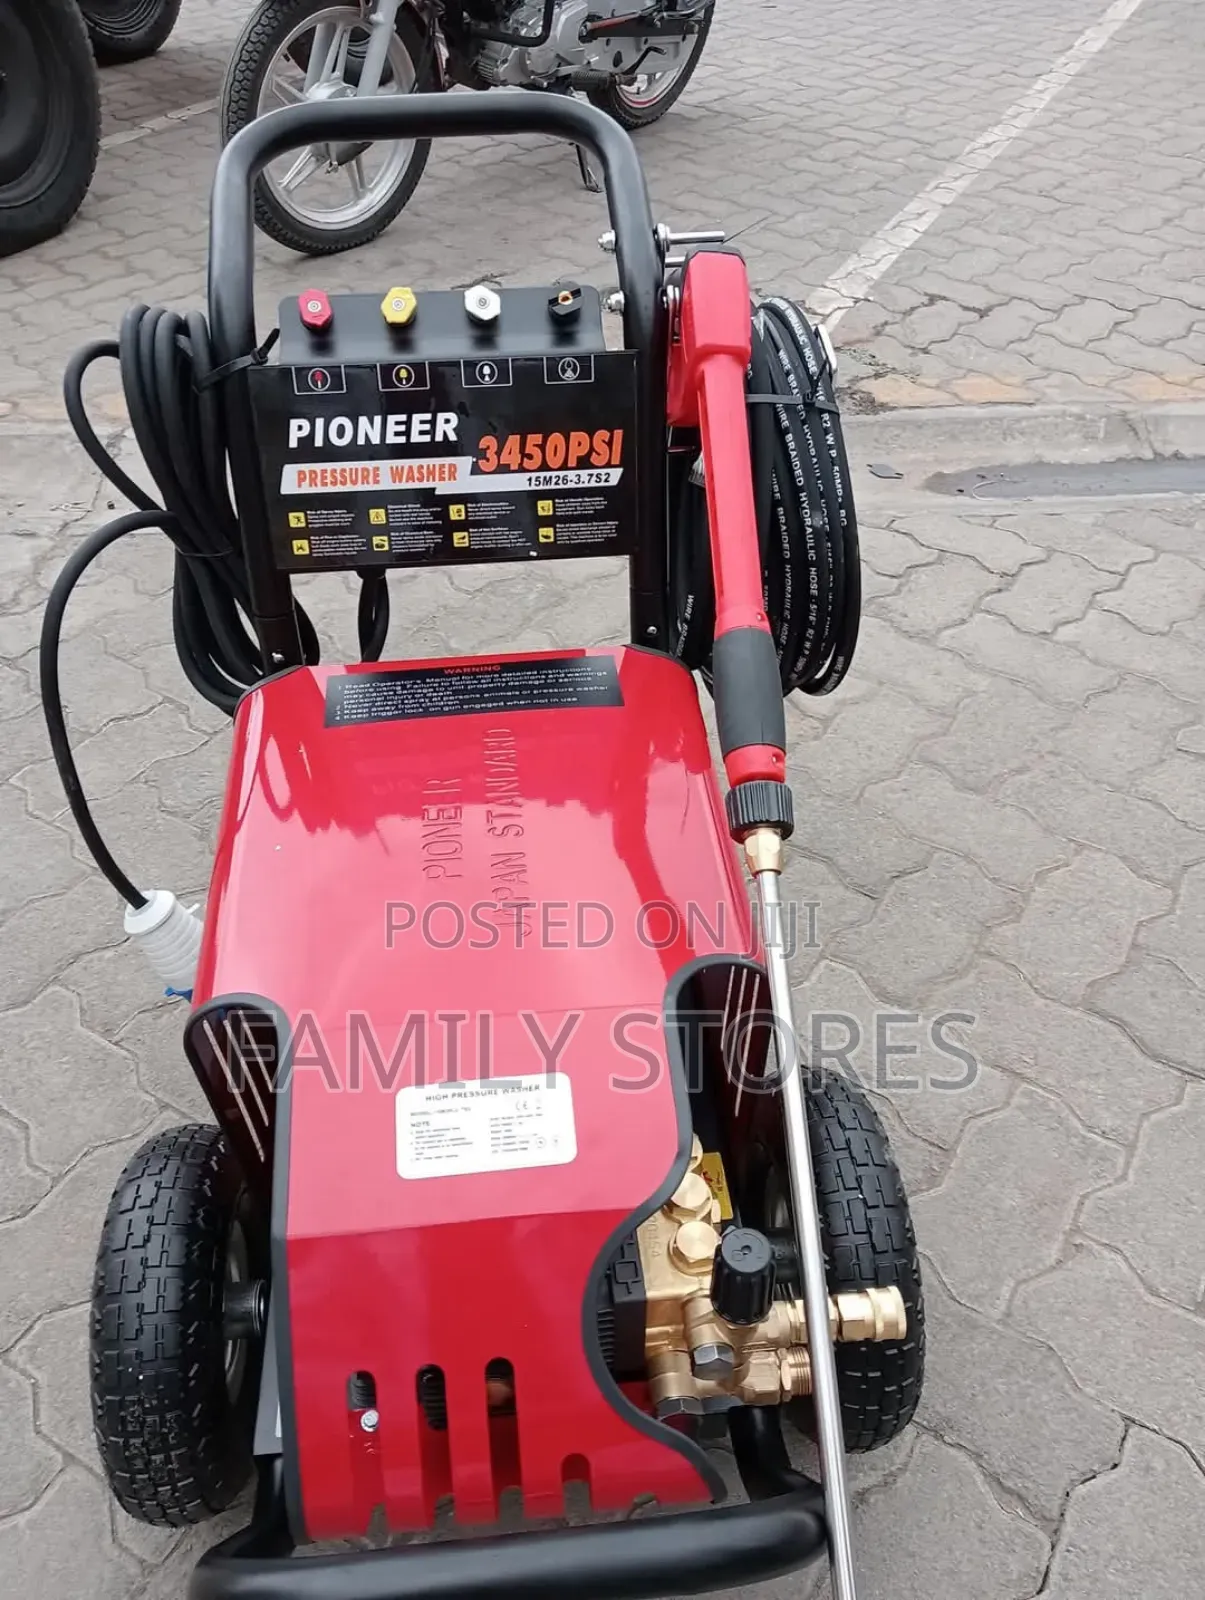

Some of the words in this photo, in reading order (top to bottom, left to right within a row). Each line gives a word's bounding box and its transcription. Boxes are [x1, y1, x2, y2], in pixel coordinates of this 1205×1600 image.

[777, 348, 791, 374] WIRE
[787, 374, 806, 420] BRAED
[803, 347, 818, 375] HOSE
[820, 412, 831, 428] R2
[289, 412, 460, 448] PIONEER
[478, 430, 624, 473] 3450PSI
[296, 466, 381, 488] PRESSURE
[390, 463, 459, 484] WASHER
[526, 472, 612, 488] 15M26-3.7S2
[776, 506, 790, 560] BRAIDED
[784, 433, 804, 486] BRAIDED
[799, 492, 816, 561] HYDRAULIC
[809, 567, 818, 596] HOSE
[684, 594, 696, 620] WIRE
[783, 564, 792, 620] HYDRAULIC
[779, 622, 789, 646] HOSE
[444, 665, 501, 675] WARNING
[483, 728, 525, 838] STANDARD
[424, 1092, 449, 1102] HIGH
[451, 1090, 499, 1099] PRESSURE
[502, 1084, 542, 1094] WASHER
